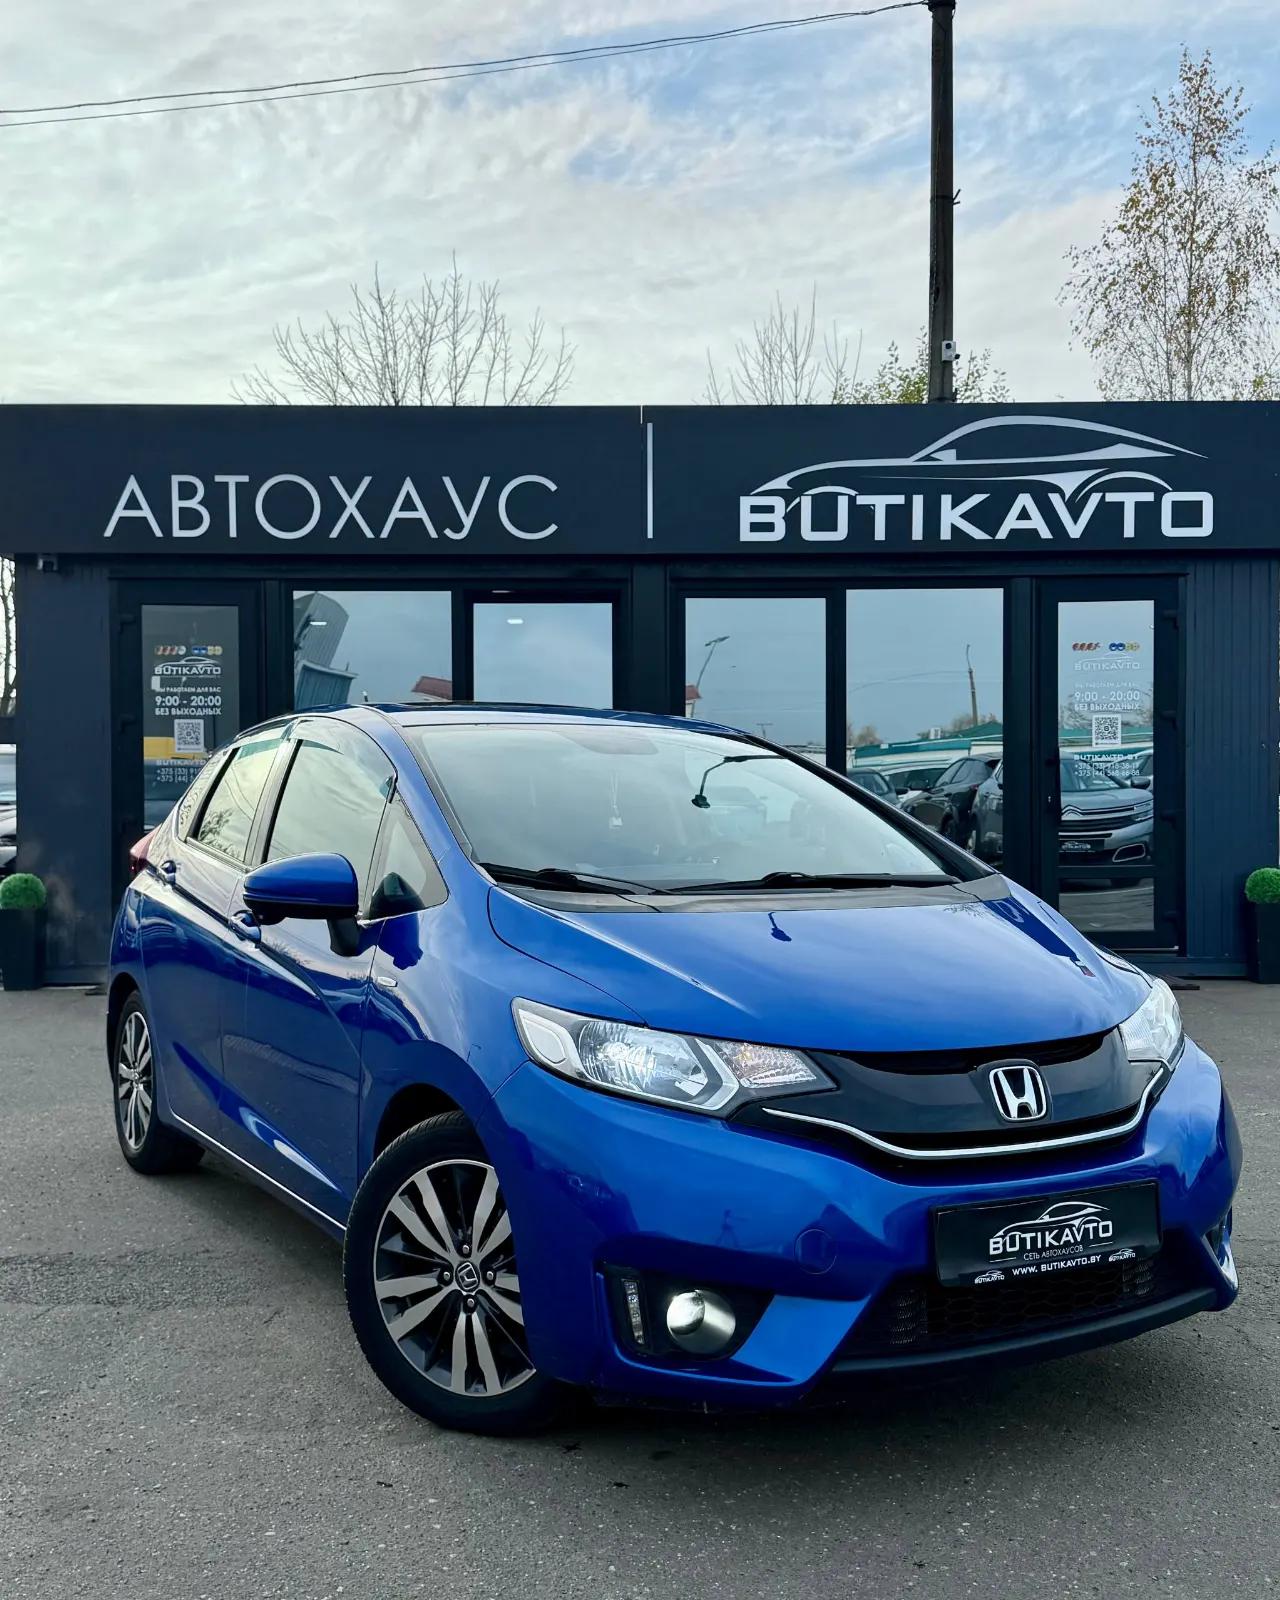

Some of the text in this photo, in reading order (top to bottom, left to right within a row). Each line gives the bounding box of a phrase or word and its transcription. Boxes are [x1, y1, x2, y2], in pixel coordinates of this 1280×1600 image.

[103, 473, 559, 540] АВТОХАУС
[739, 491, 1214, 542] BUTIKAVTO
[154, 666, 221, 675] BUTIKAVTO
[1074, 662, 1140, 671] BUTIKAVTO
[155, 696, 180, 706] 9:00
[190, 695, 222, 706] 20:00
[1074, 692, 1098, 701] 9:00
[1109, 691, 1140, 701] 20:00
[171, 708, 222, 716] ВЫХОДНЫХ
[1074, 702, 1140, 711] БЕЗ ВЫХОДНЫХ
[989, 1220, 1113, 1256] BUTIKAVTO
[1023, 1244, 1084, 1261] СЕТЬ АВТОХАУСОВ
[1108, 1251, 1136, 1262] BUTIKAVTO
[1012, 1254, 1102, 1276] WWW. BUTIKAVTO.BY
[974, 1274, 1005, 1284] BUTIKAVTO
